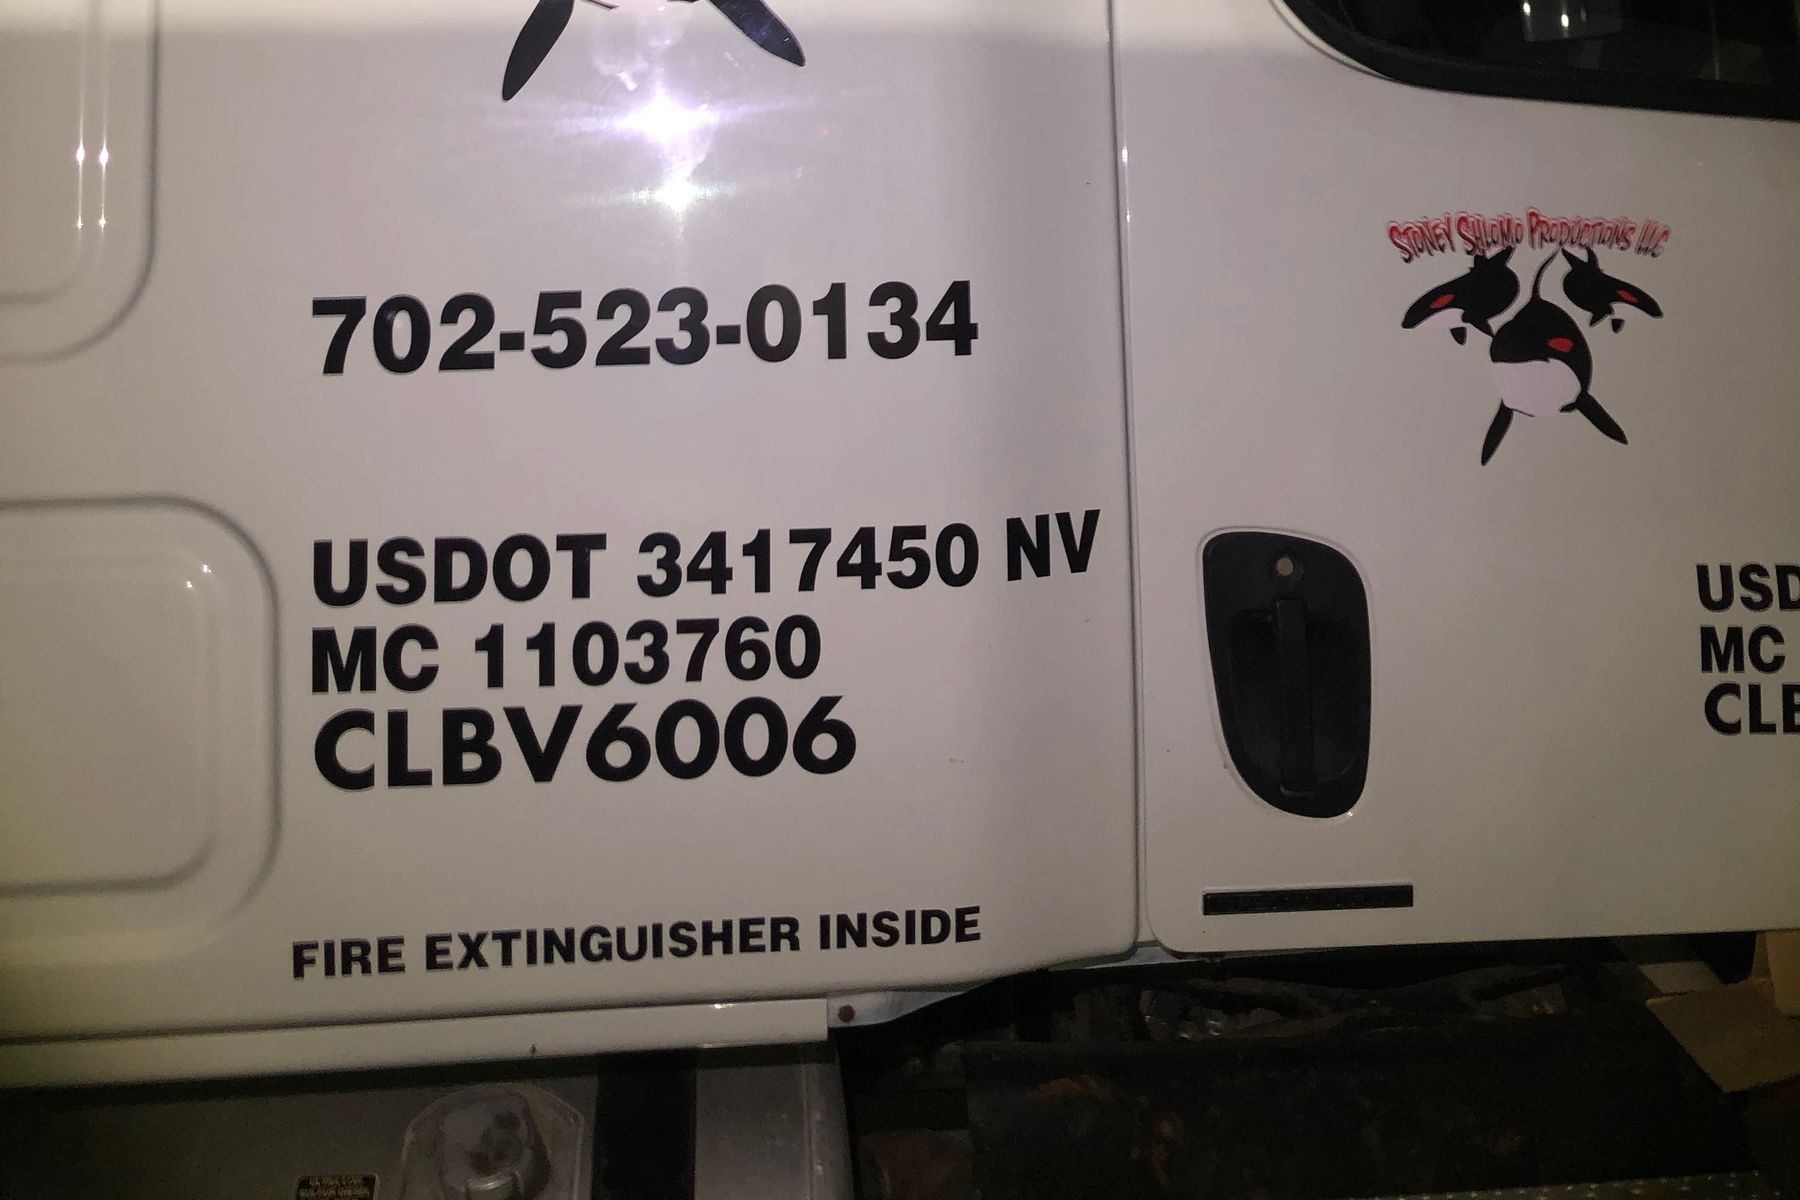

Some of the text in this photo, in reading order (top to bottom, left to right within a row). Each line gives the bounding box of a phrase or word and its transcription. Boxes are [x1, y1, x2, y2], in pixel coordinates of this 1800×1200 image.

[1388, 212, 1455, 264] STONEY
[1526, 206, 1637, 251] PRODUCTIONS
[1635, 218, 1671, 258] LLC
[312, 280, 979, 375] 702-523-0134
[313, 508, 1101, 607] USDOT 3417450 NV
[311, 614, 821, 693] MC 1103760
[1700, 624, 1786, 675] MC
[314, 695, 857, 791] CLBV6006
[292, 905, 981, 980] FIRE EXTINGUISHER INSIDE
